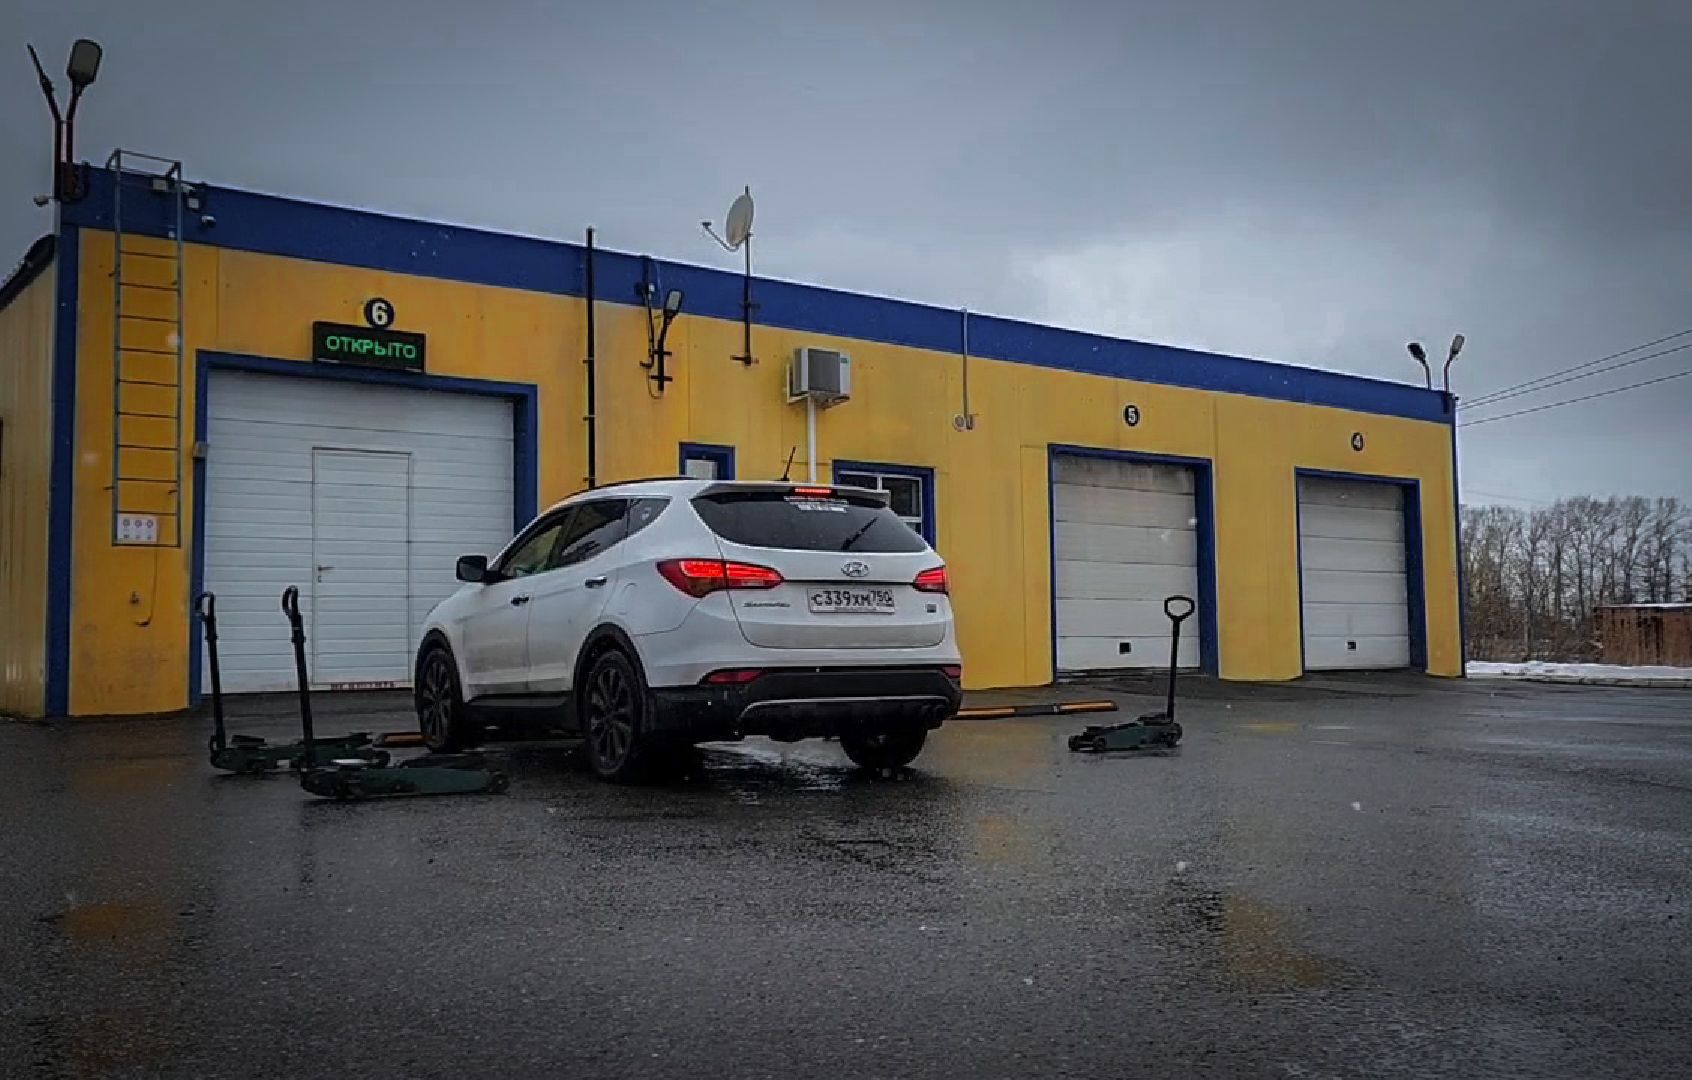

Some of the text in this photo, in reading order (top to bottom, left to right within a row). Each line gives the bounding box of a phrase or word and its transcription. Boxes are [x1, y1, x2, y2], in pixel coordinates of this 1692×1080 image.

[372, 302, 388, 325] 6
[326, 335, 416, 359] ОТКРЫТО
[1128, 407, 1136, 423] 5
[1353, 434, 1361, 449] 4
